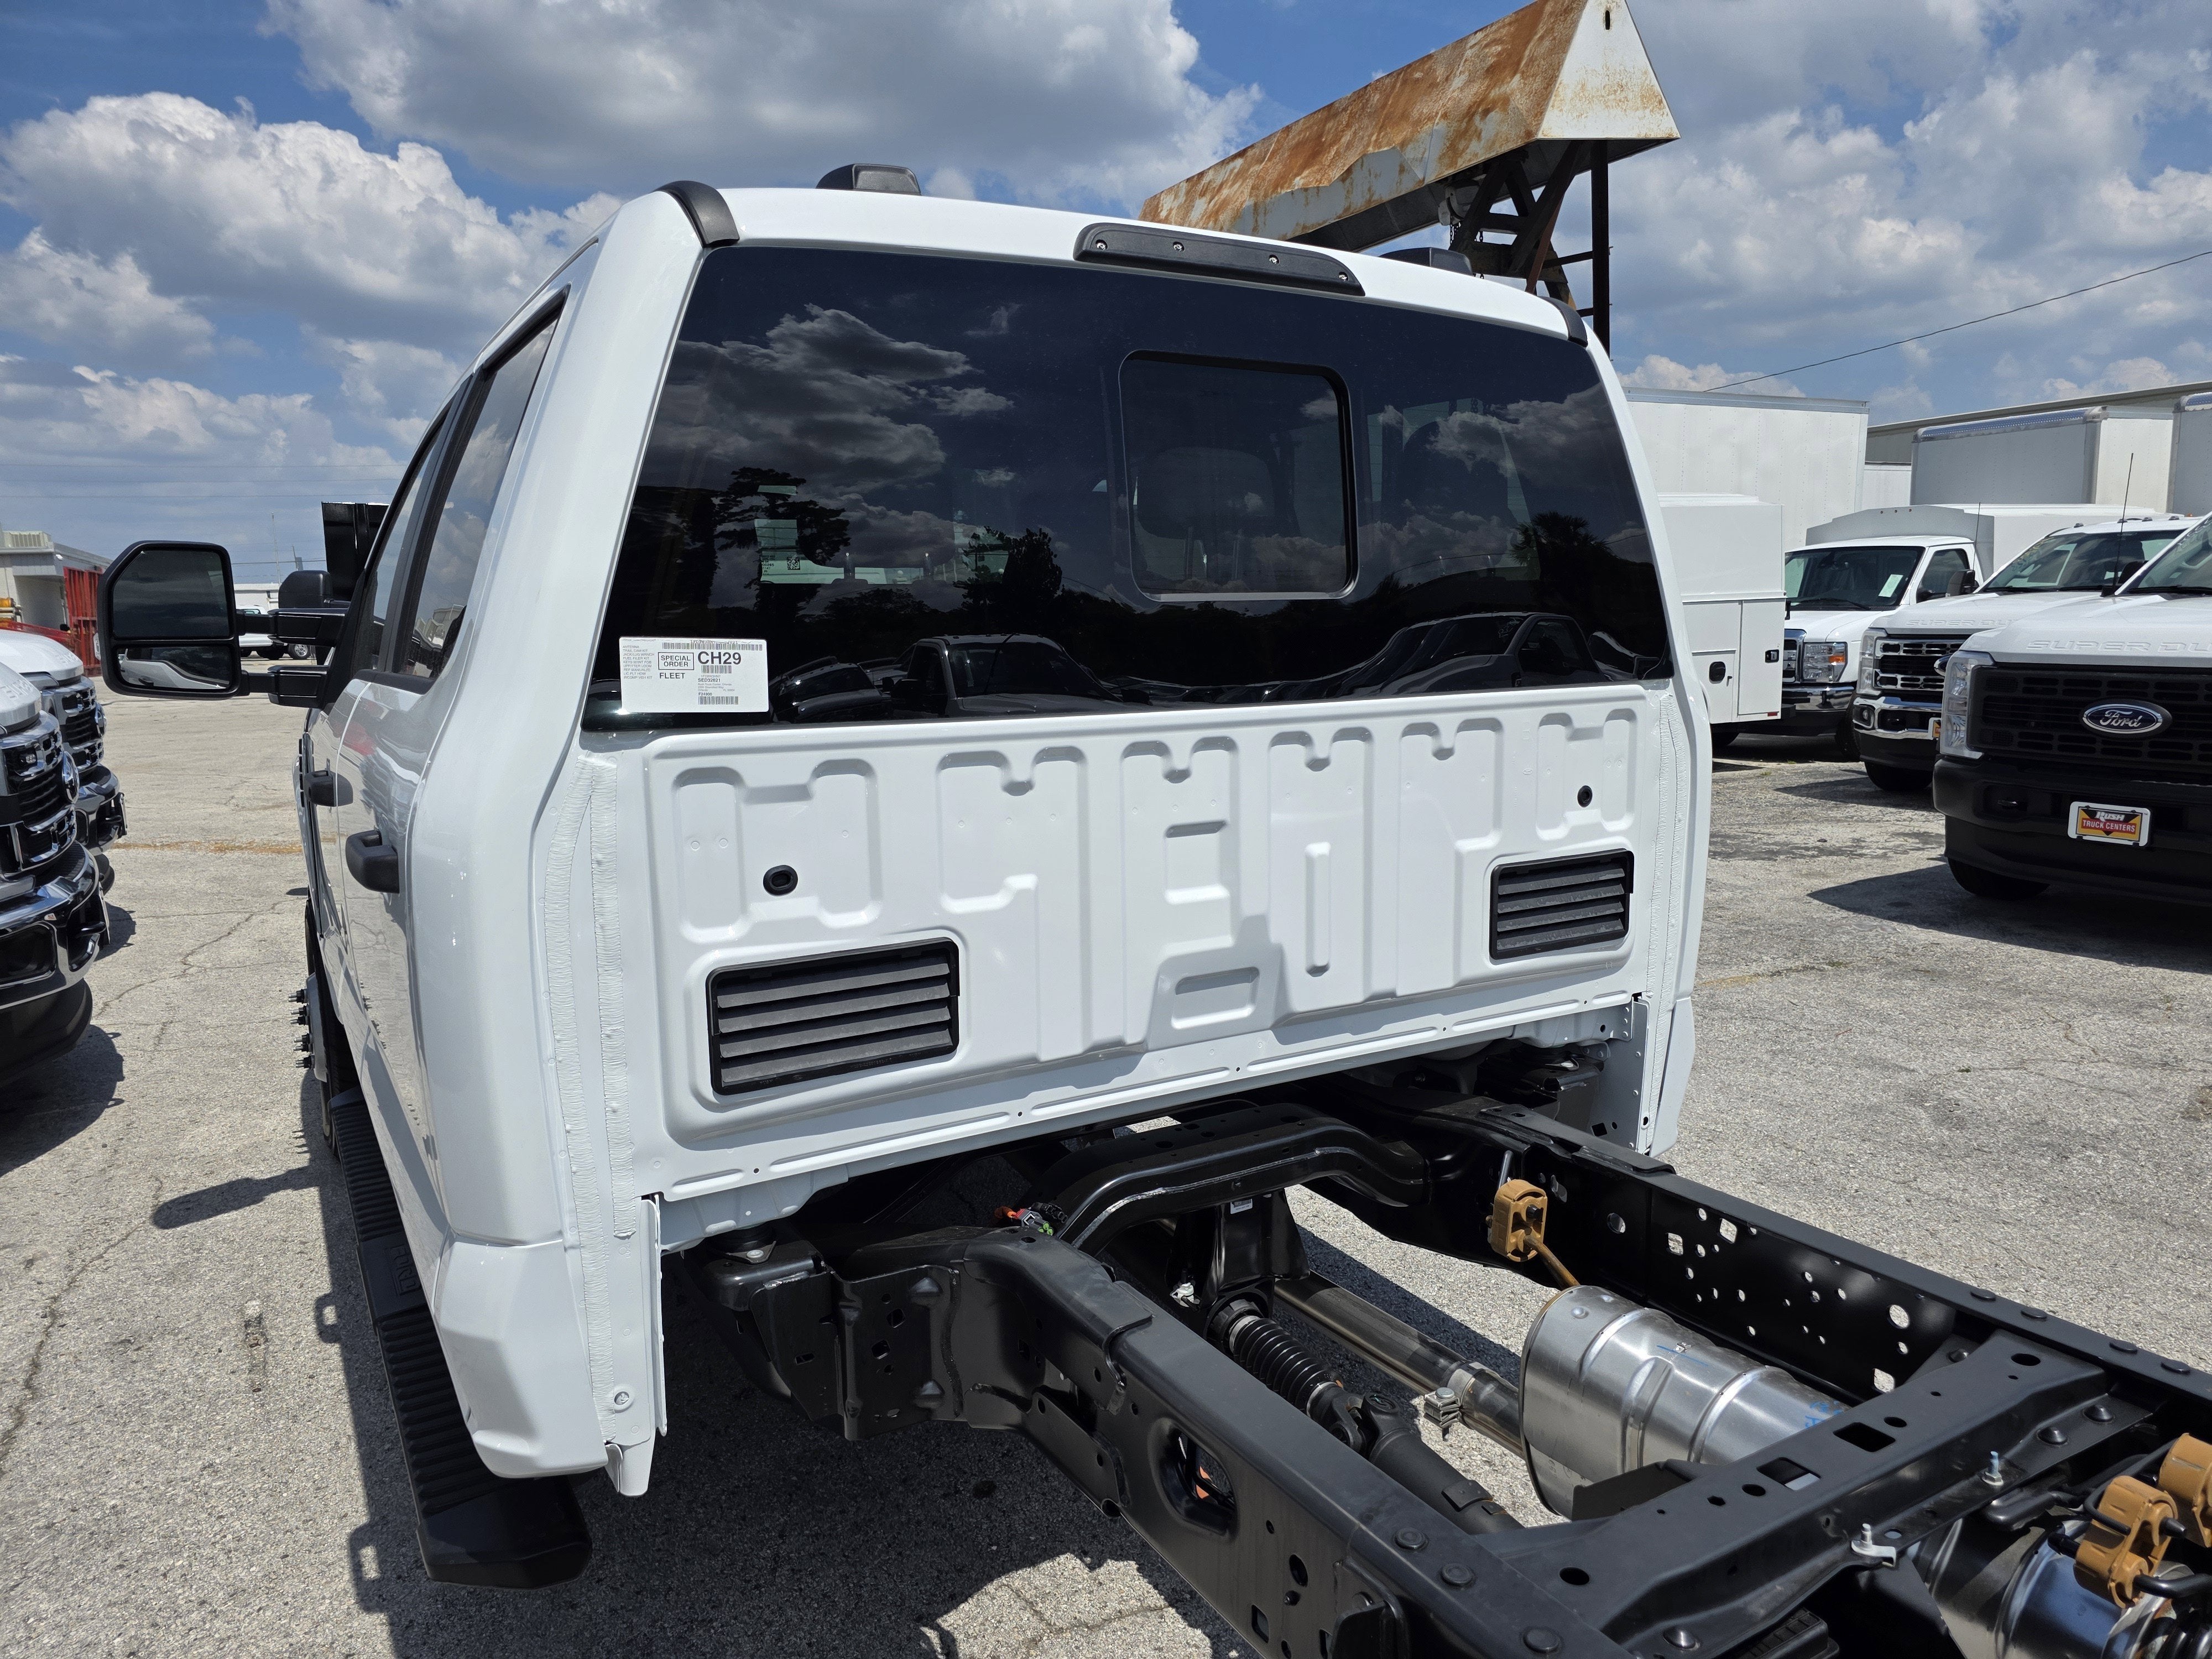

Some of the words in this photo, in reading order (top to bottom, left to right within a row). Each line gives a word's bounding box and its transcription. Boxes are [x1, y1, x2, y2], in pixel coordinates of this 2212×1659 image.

[2026, 640, 2151, 652] SUPER
[697, 651, 742, 665] CH29
[2099, 709, 2143, 728] Ford
[2094, 811, 2125, 822] RUSH
[2083, 820, 2104, 829] TRUCK
[2105, 822, 2135, 832] CENTERS
